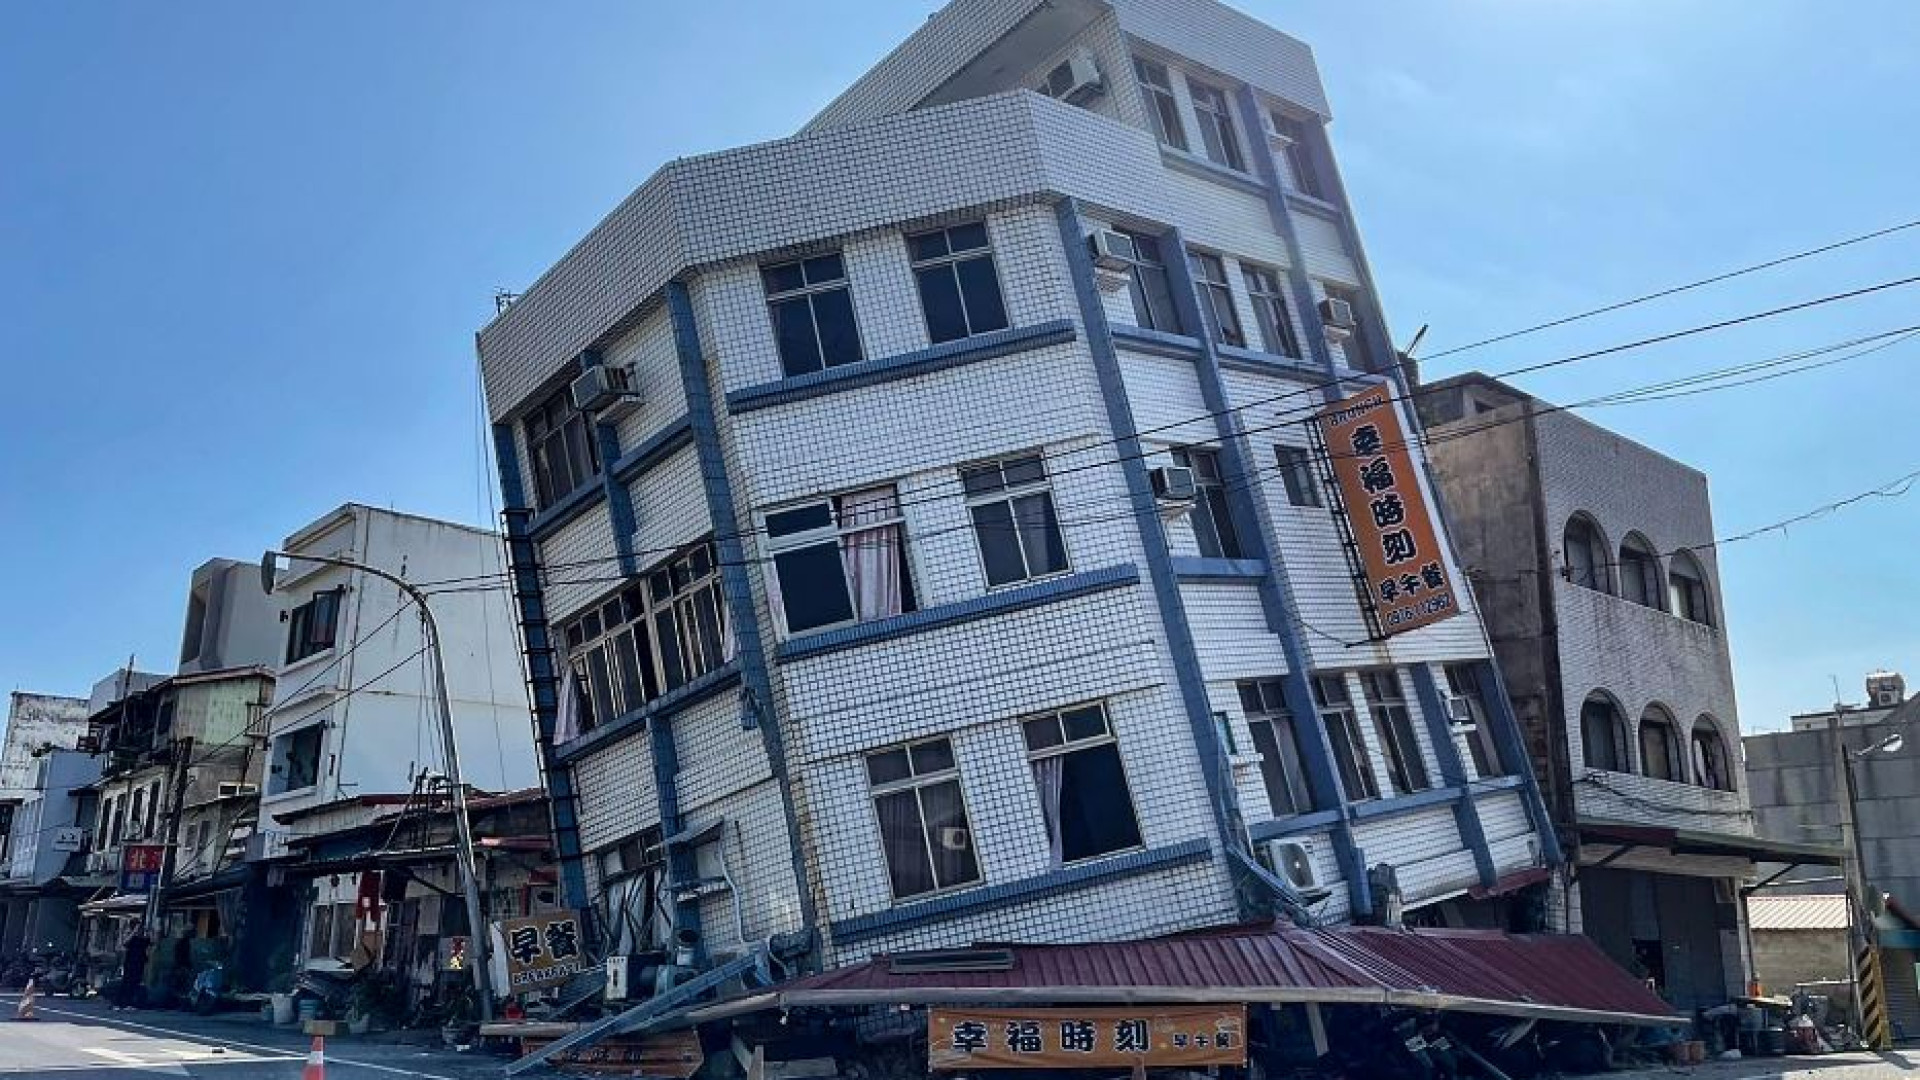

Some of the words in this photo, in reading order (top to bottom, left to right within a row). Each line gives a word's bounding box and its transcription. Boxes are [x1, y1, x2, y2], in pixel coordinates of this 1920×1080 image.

[1350, 425, 1416, 564] 幸福時刻
[1379, 560, 1444, 603] 早午餐
[510, 920, 578, 964] 早餐
[953, 1019, 1150, 1053] 幸福時刻
[1172, 1032, 1231, 1049] 早午餐
